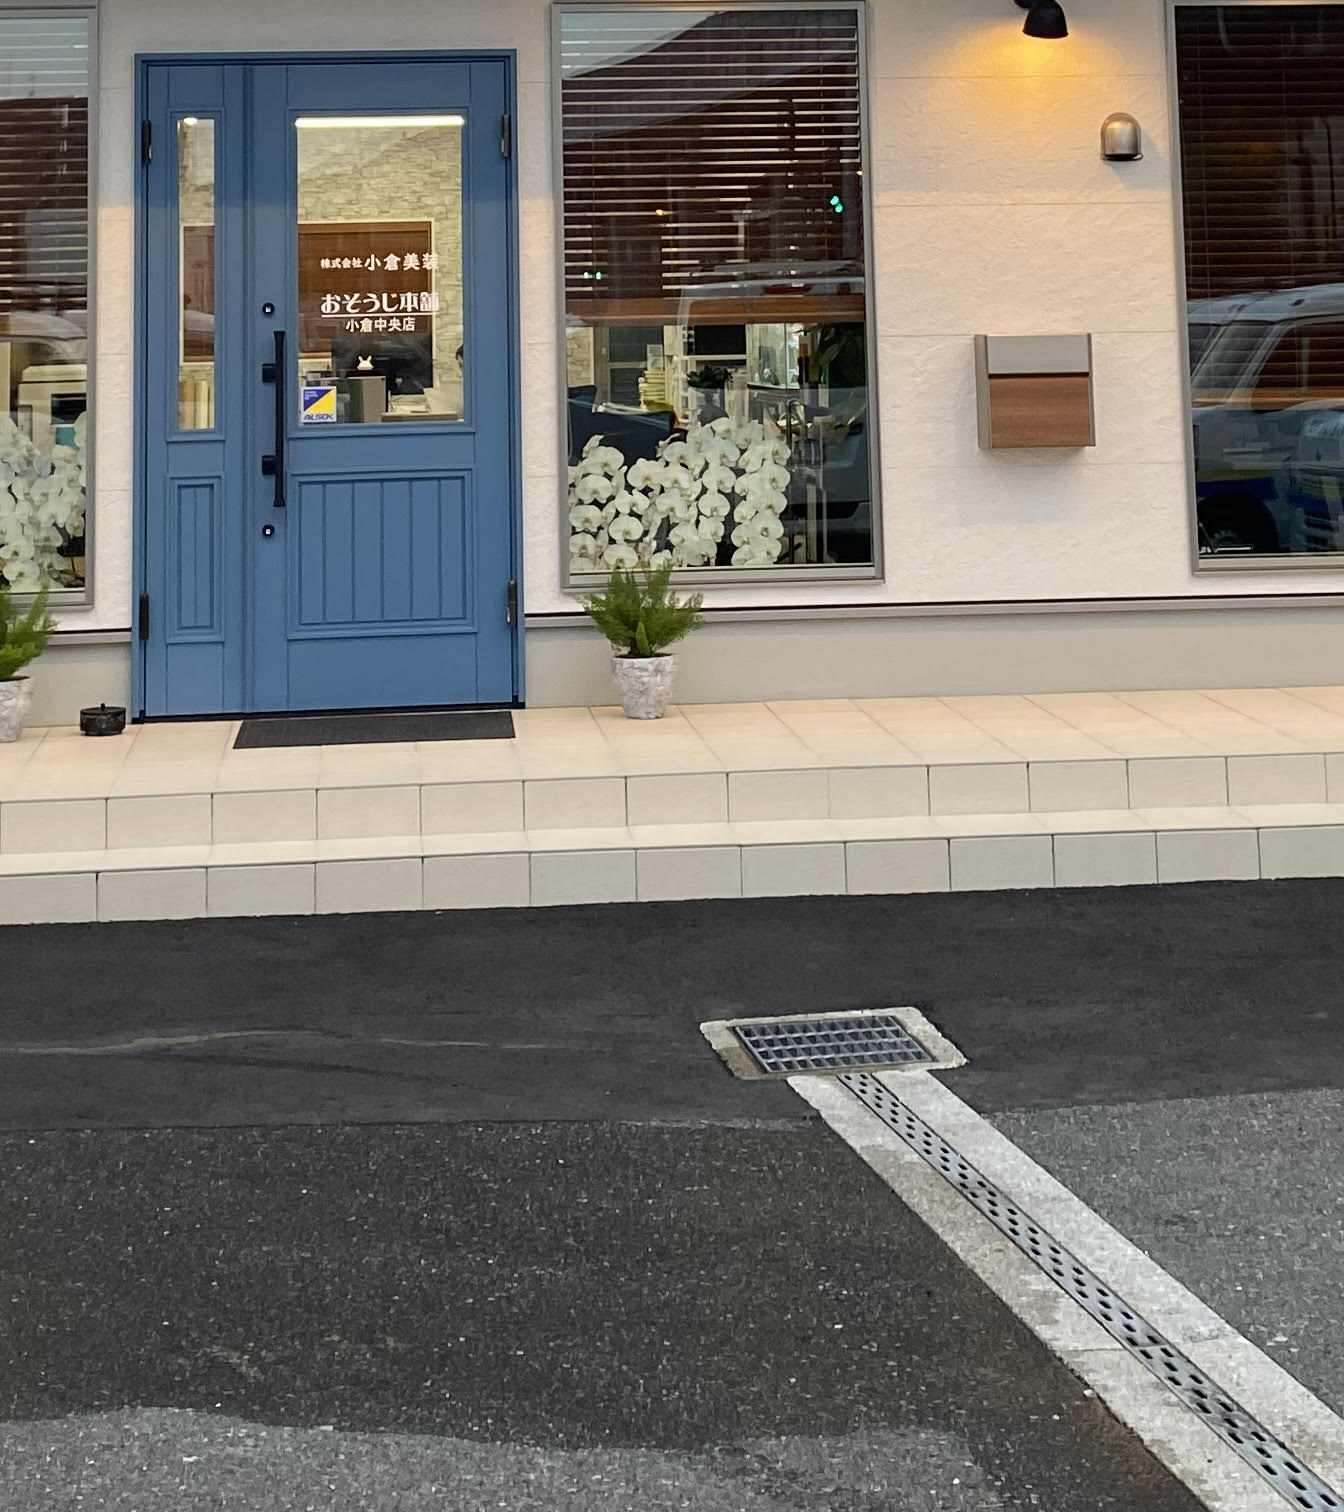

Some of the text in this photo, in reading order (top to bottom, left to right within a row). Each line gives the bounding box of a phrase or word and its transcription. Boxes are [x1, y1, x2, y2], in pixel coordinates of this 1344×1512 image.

[320, 252, 440, 271] 株式会社 小倉美装
[321, 291, 440, 314] おそうじ本舗
[345, 316, 416, 333] 小倉中央店
